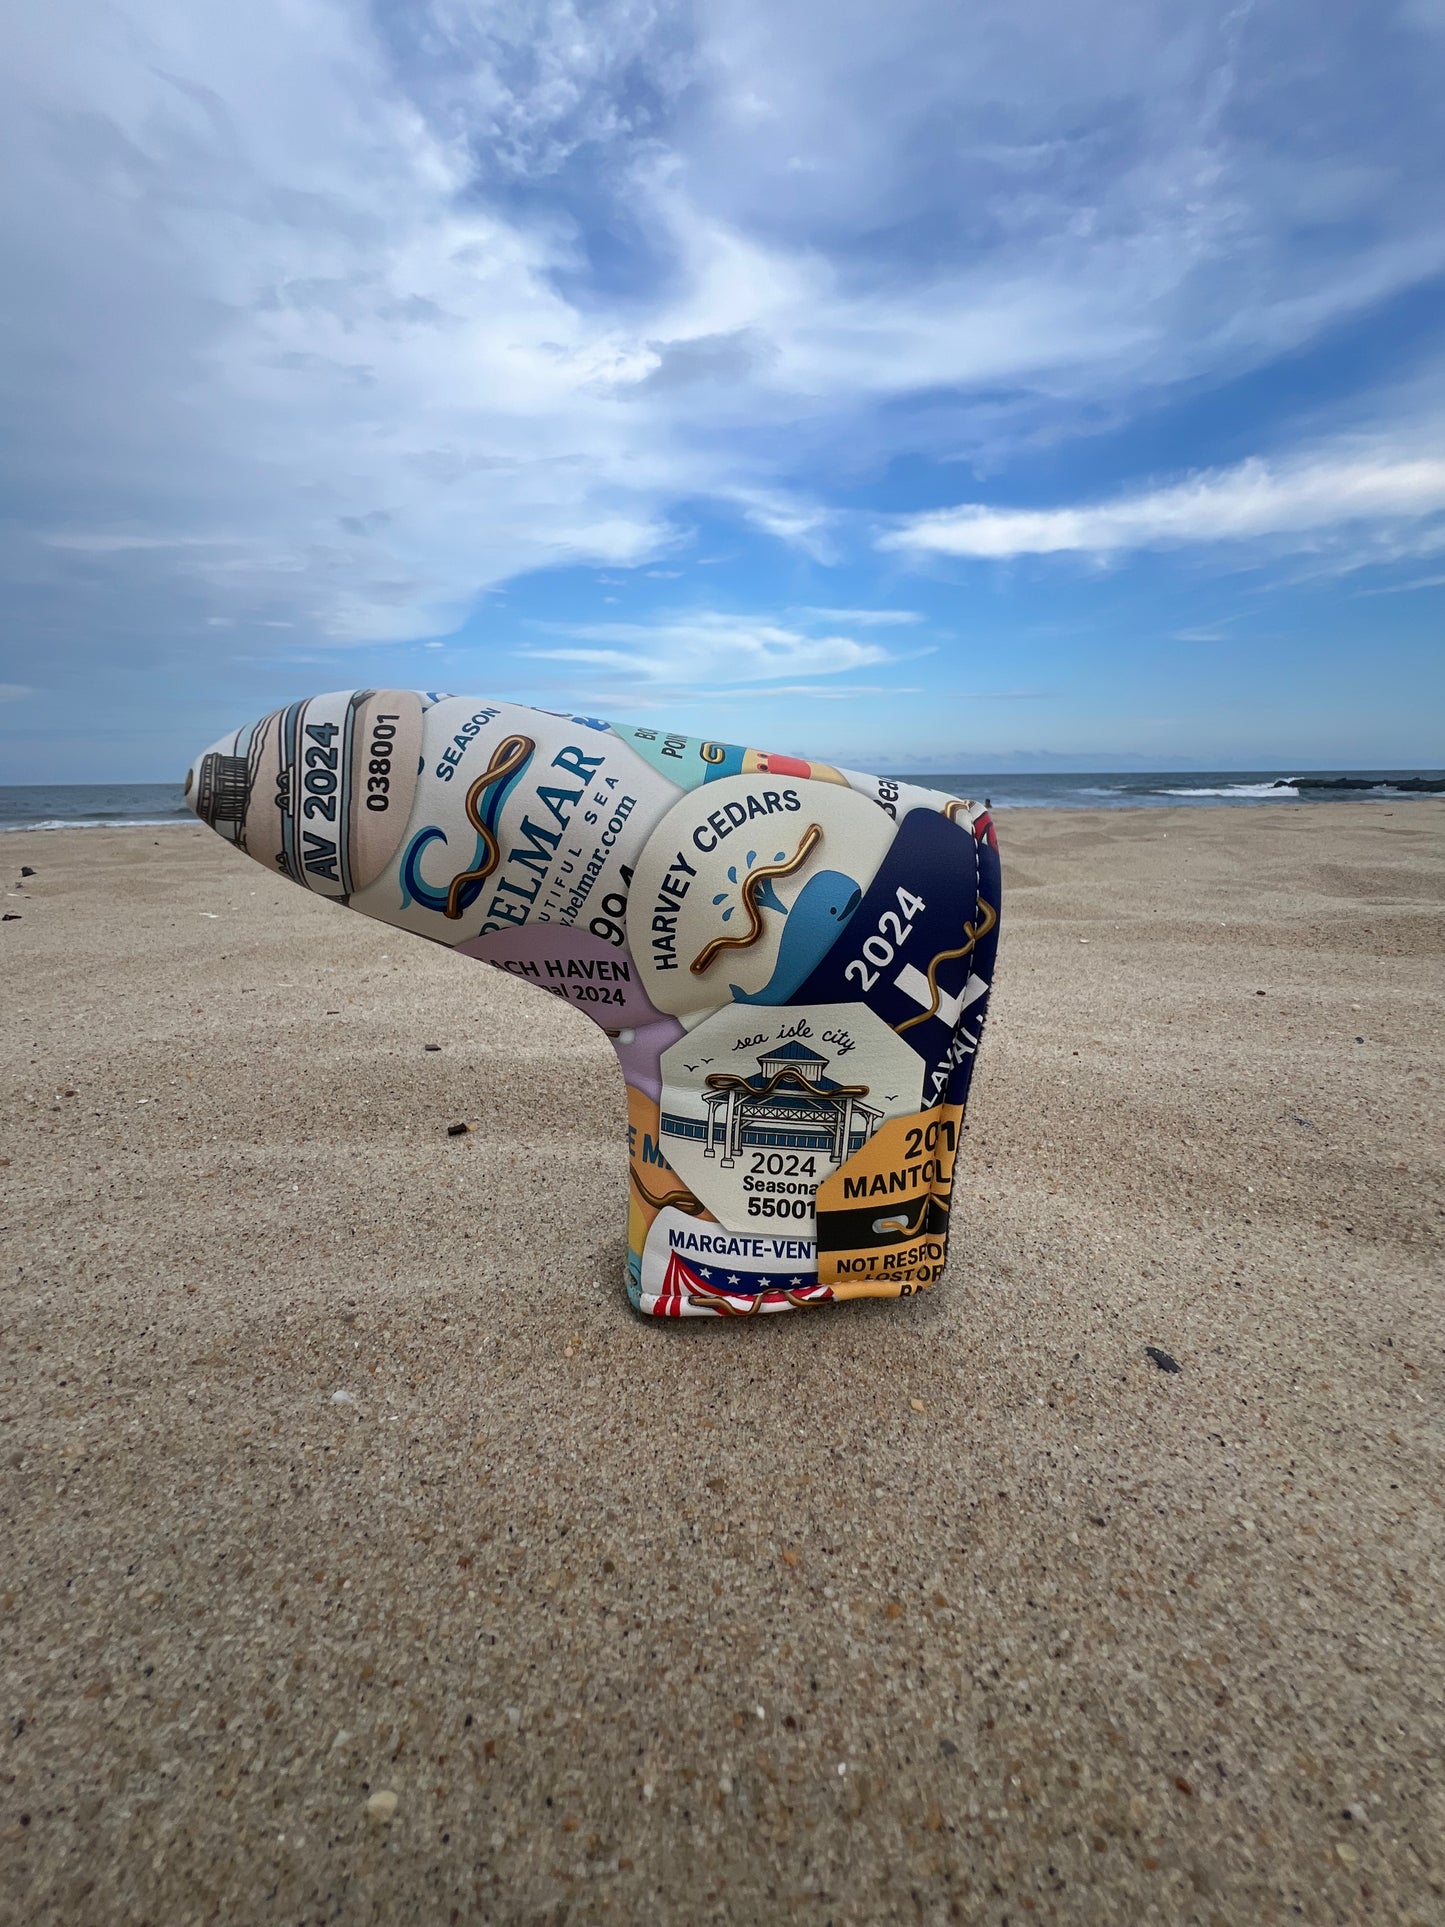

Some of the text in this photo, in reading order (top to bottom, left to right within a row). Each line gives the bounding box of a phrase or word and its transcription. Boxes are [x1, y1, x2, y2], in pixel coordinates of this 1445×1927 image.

[366, 714, 400, 812] 038001
[436, 707, 501, 782] SEASON
[303, 723, 339, 881] AV 2024
[584, 777, 619, 825] SEA
[651, 789, 801, 970] HARVEY CEDARS
[844, 886, 926, 992] 2024
[544, 959, 631, 982] HAVEN
[572, 985, 626, 1006] 2024
[731, 1018, 856, 1056] sea isle city
[750, 1152, 817, 1178] 2024
[742, 1175, 824, 1196] Seasona
[747, 1196, 817, 1219] 55001
[837, 1256, 879, 1274] NOT
